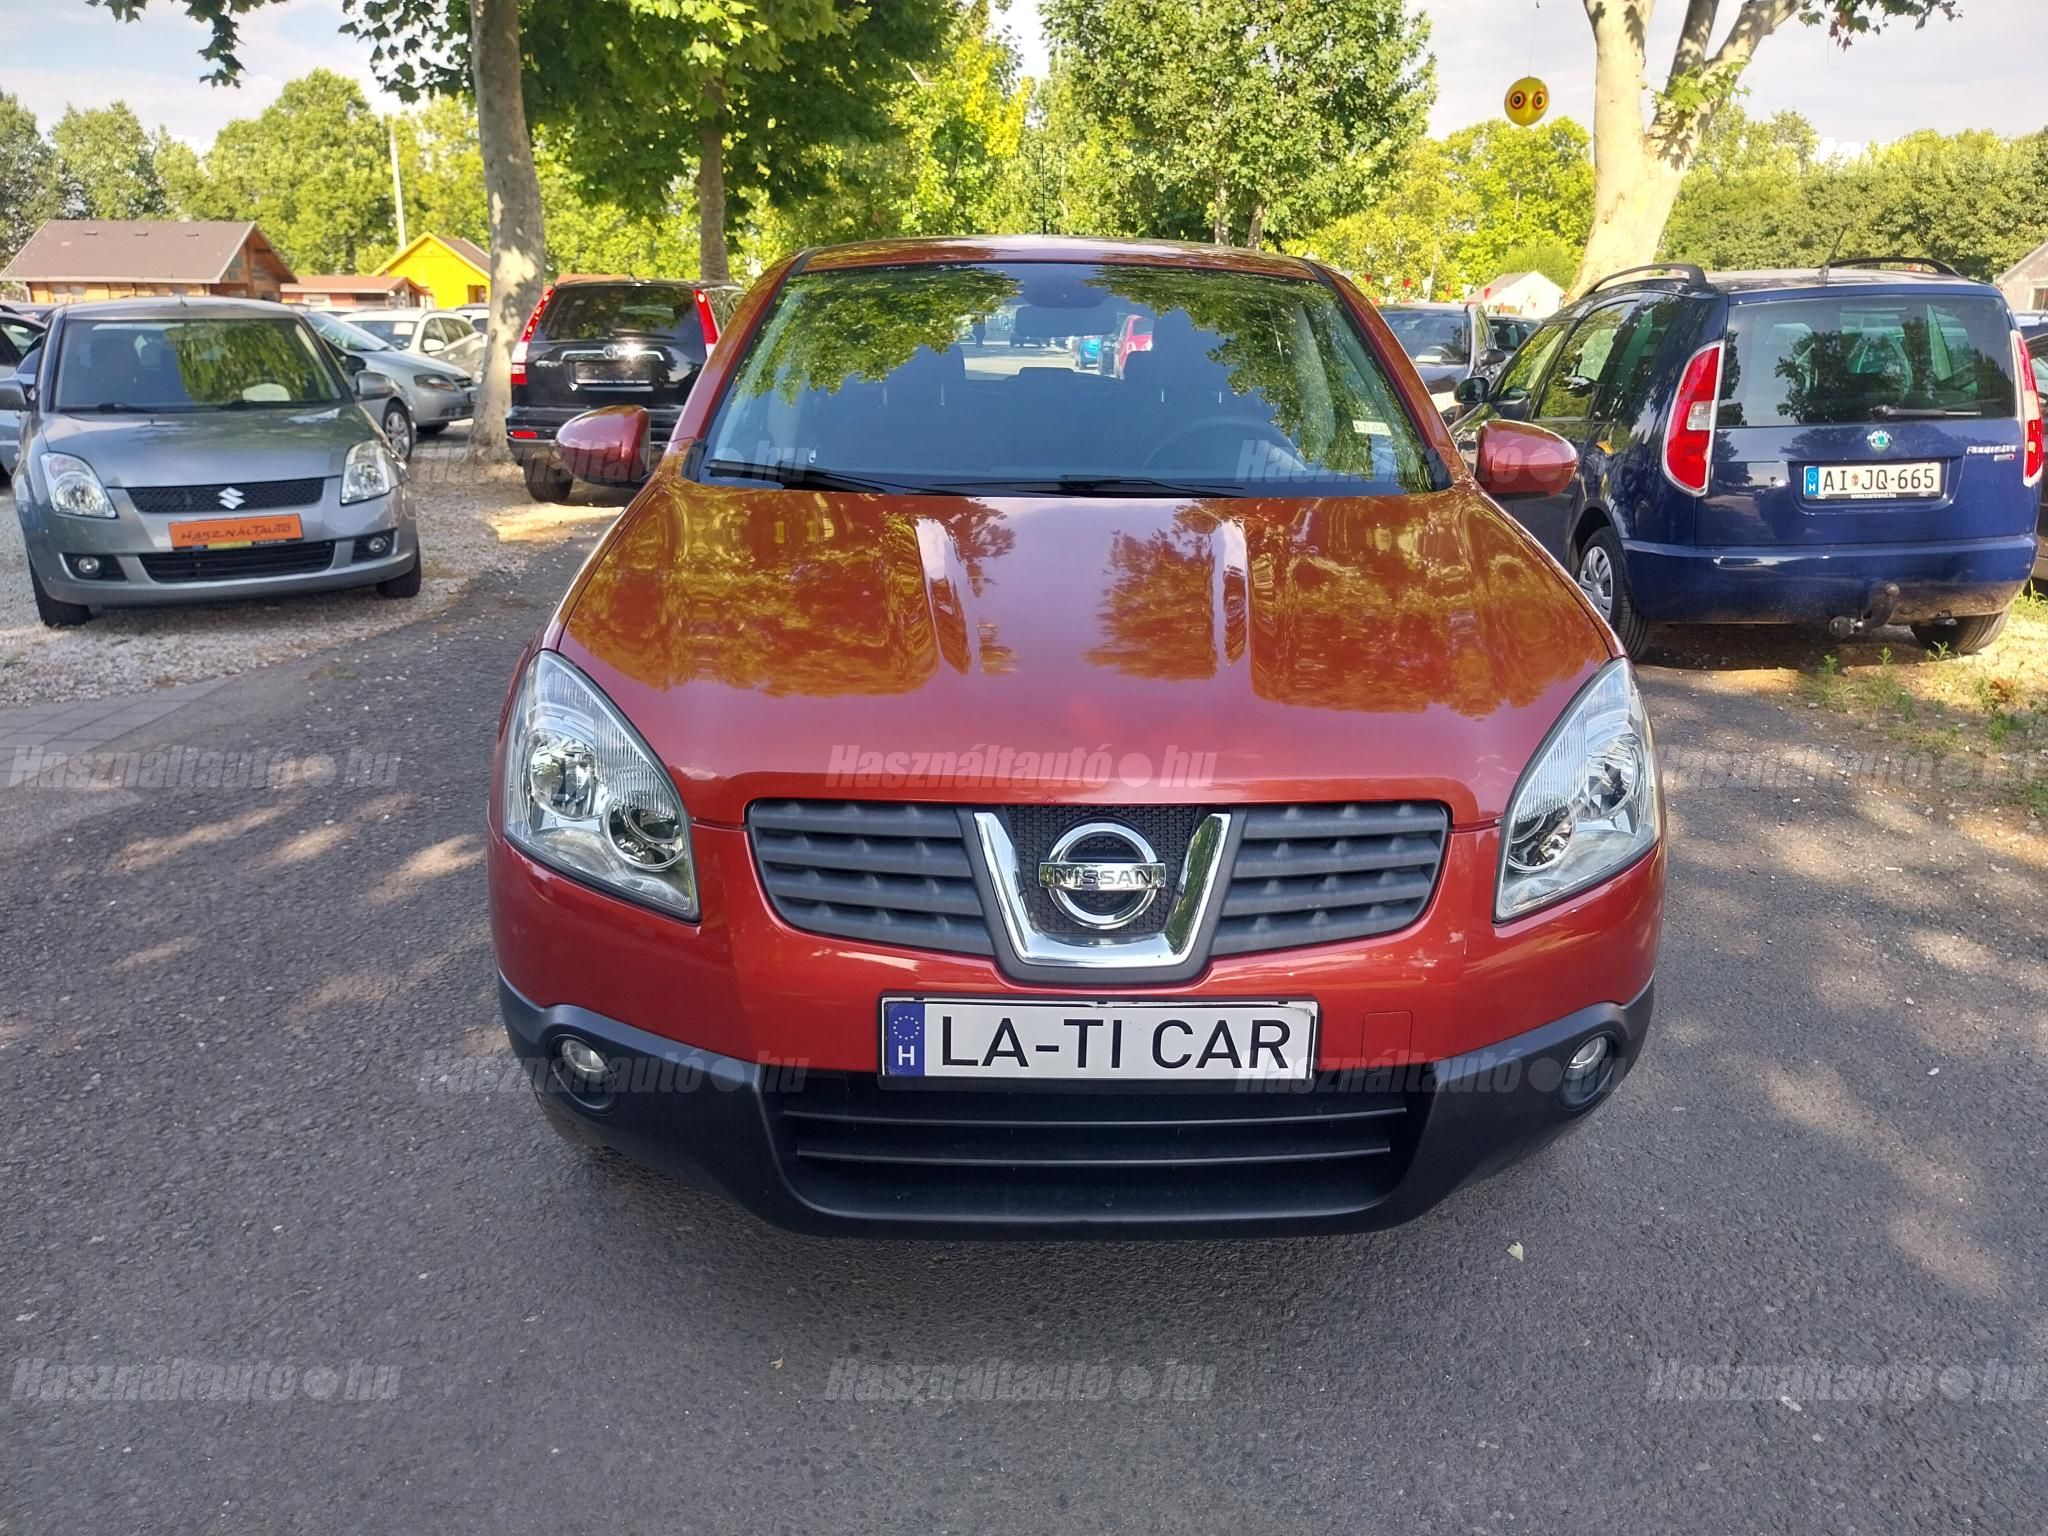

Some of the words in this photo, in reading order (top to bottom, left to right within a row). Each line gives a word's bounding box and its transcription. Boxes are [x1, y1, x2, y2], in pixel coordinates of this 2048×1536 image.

[1823, 470, 1848, 491] AI
[1862, 468, 1934, 490] JQ-665
[1053, 867, 1154, 888] NISSAN
[941, 1015, 1121, 1069] LA-TI
[1151, 1018, 1291, 1069] CAR
[897, 1045, 915, 1067] H
